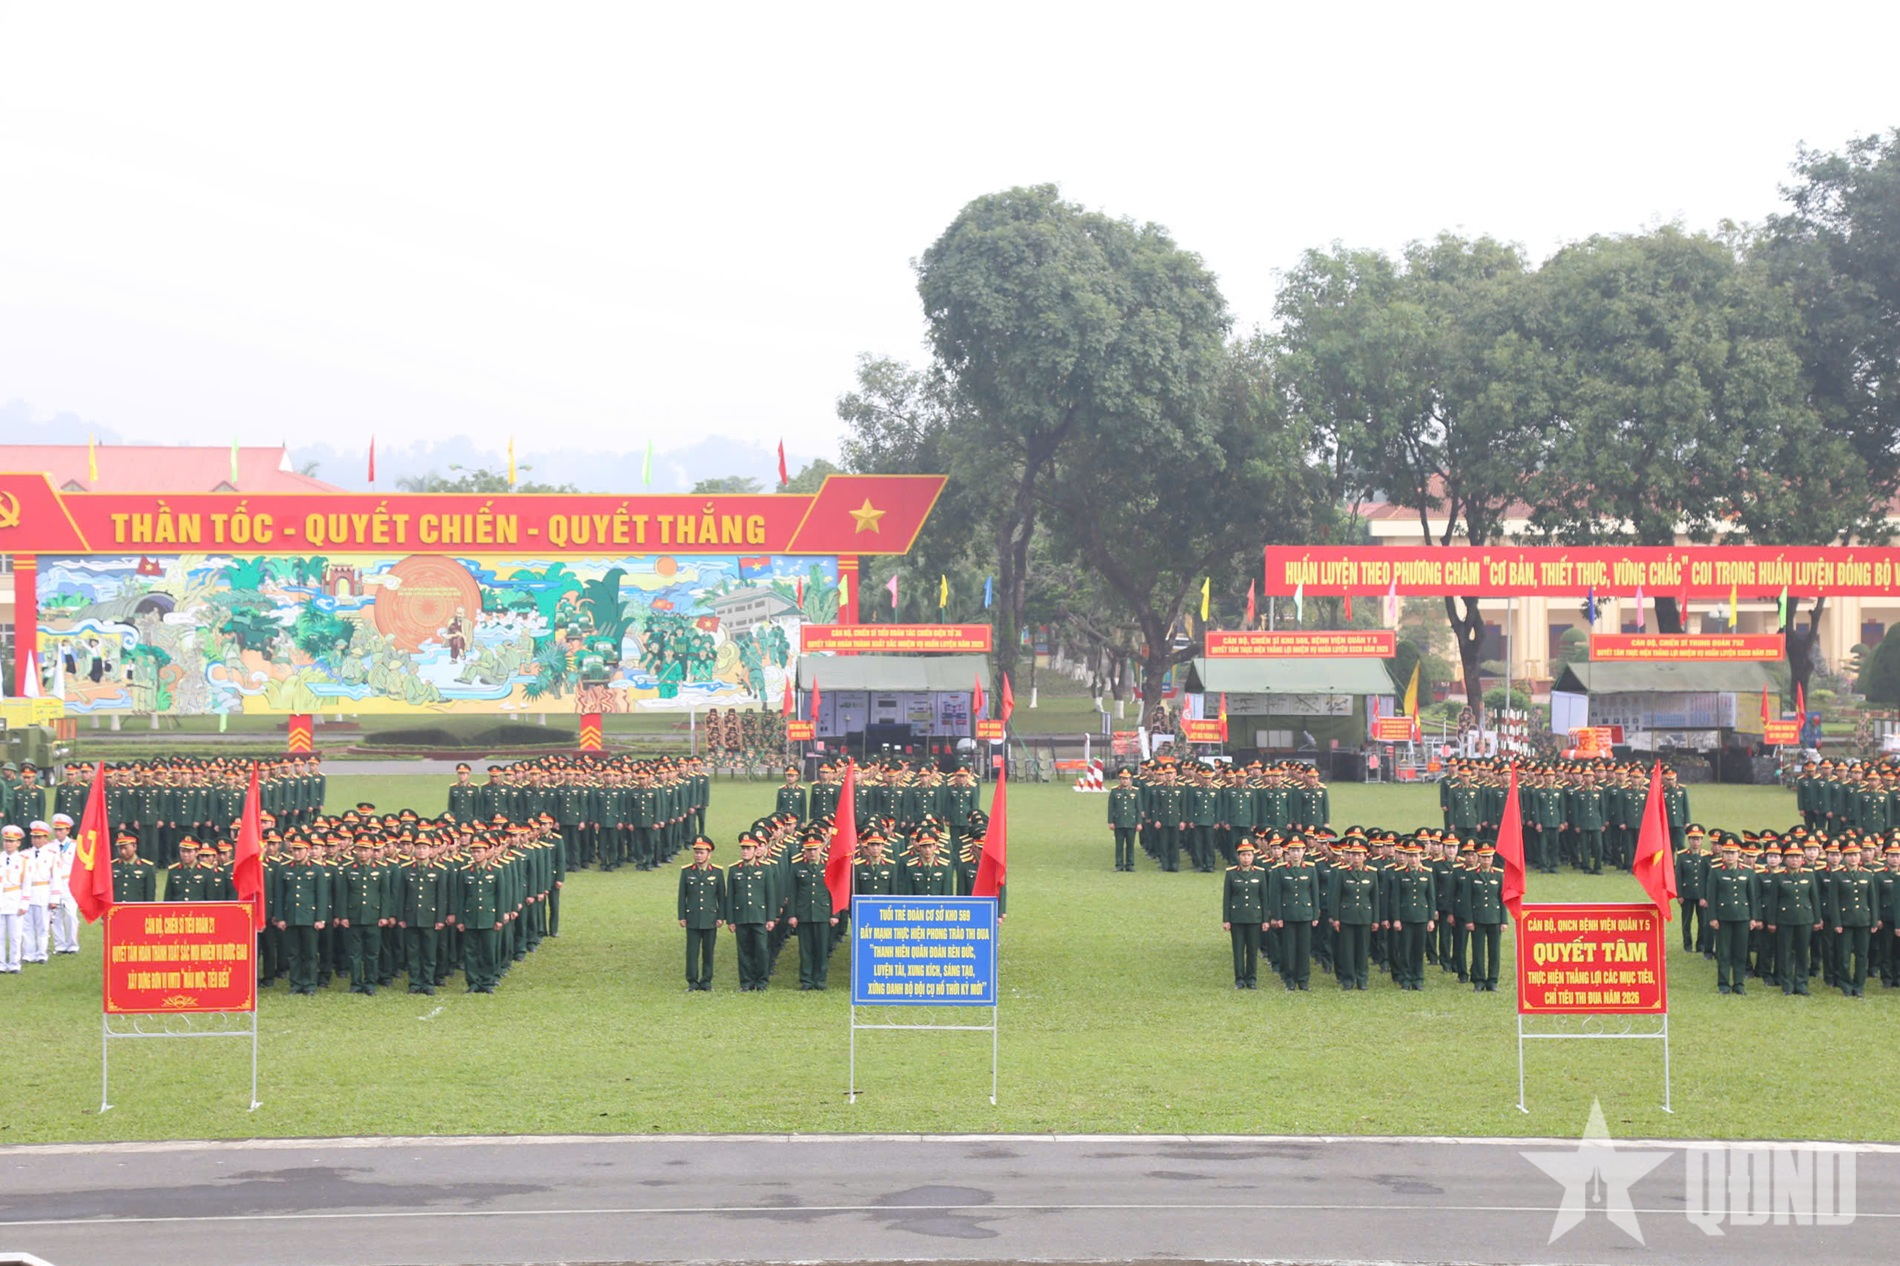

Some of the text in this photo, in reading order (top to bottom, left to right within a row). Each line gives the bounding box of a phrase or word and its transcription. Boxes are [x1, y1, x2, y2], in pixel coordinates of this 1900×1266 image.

[111, 500, 201, 542] THẦN
[211, 500, 273, 543] TỐC
[306, 500, 409, 546] QUYẾT
[419, 500, 517, 543] CHIẾN
[549, 501, 649, 547] QUYẾT
[657, 502, 765, 544] THẮNG
[1321, 557, 1358, 590] LUYỆN
[1360, 561, 1390, 585] THEO
[1393, 559, 1442, 586] PHƯƠNG
[1445, 557, 1480, 585] CHÂM
[1509, 554, 1538, 588] BẢN,
[1540, 555, 1574, 586] THIẾT
[1613, 558, 1646, 586] VỮNG
[1692, 561, 1712, 585] COI
[1758, 553, 1792, 586] HUẤN
[1795, 557, 1834, 591] LUYỆN
[1837, 554, 1871, 586] ĐỒNG
[1874, 558, 1891, 591] BỘ
[1527, 918, 1543, 931] CÁN
[1544, 917, 1556, 934] BỘ,
[1579, 917, 1598, 933] BỆNH
[1600, 917, 1616, 933] VIỆN
[1618, 917, 1638, 932] QUÂN
[1533, 936, 1648, 966] QUYẾT TÂM
[1527, 967, 1655, 987] THỰC HIỆN THẮNG LỢI CÁC MỤC TIÊU,
[1544, 988, 1640, 1004] CHỈ TIÊU THI ĐUA NĂM 2026
